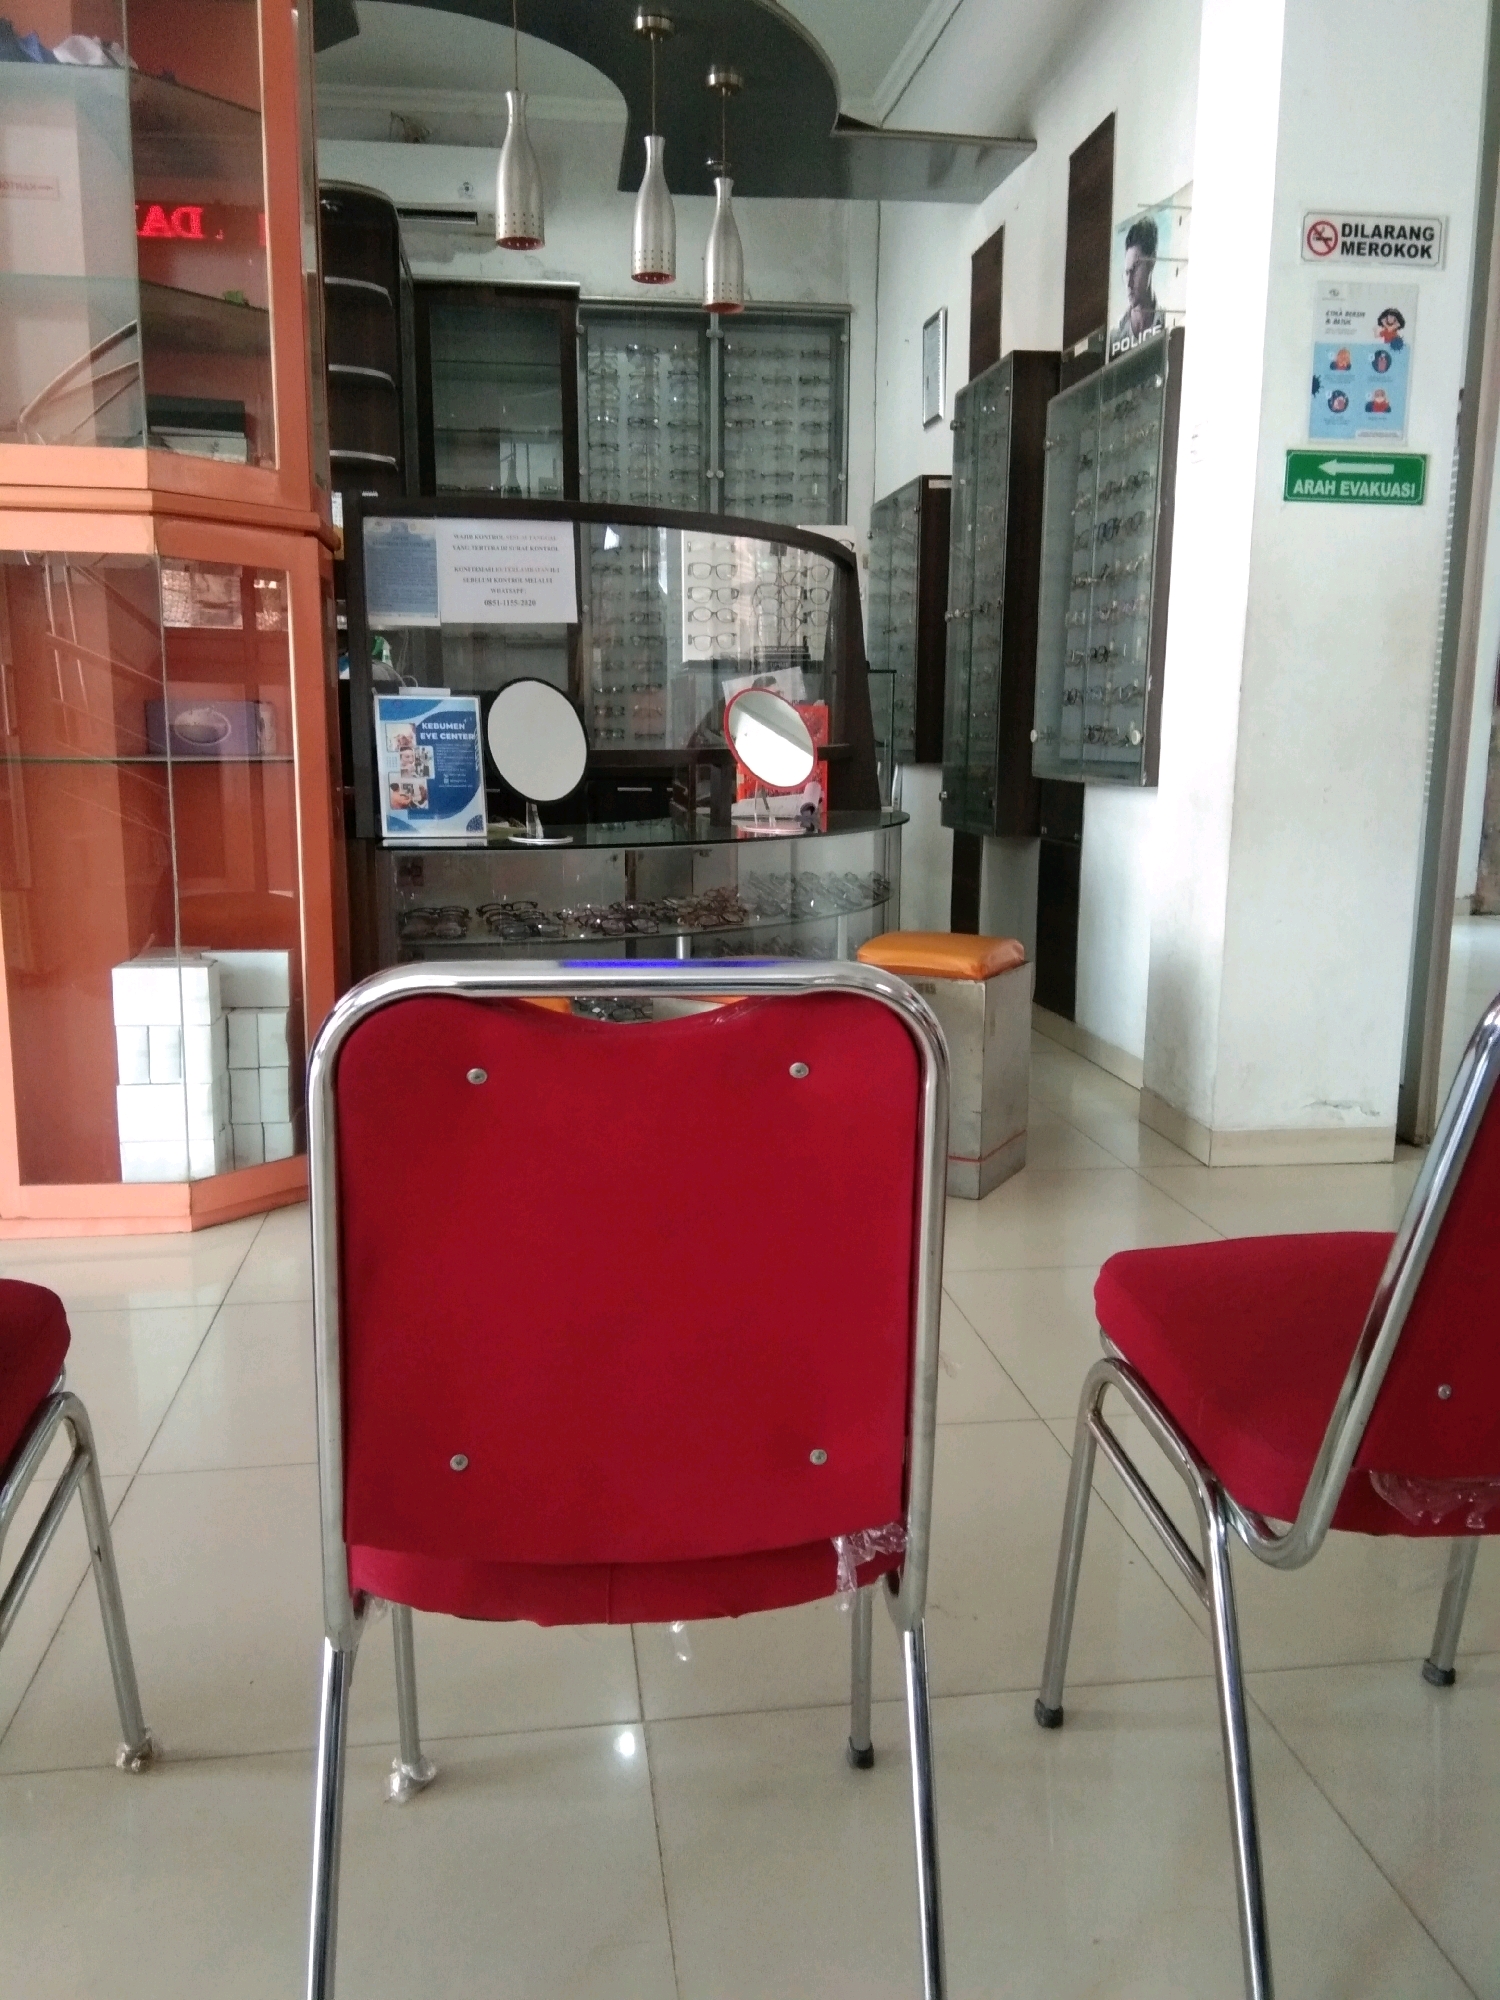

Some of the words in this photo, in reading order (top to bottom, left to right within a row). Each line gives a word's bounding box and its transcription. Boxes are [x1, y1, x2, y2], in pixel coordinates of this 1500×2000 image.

[1342, 222, 1435, 242] DILARANG
[1340, 240, 1433, 259] MEROKOK
[1293, 478, 1337, 496] ARAH
[1339, 480, 1416, 498] EVAKUASI
[421, 722, 466, 731] KEBUMEN
[420, 732, 439, 741] EYE
[439, 732, 475, 741] CENTER
